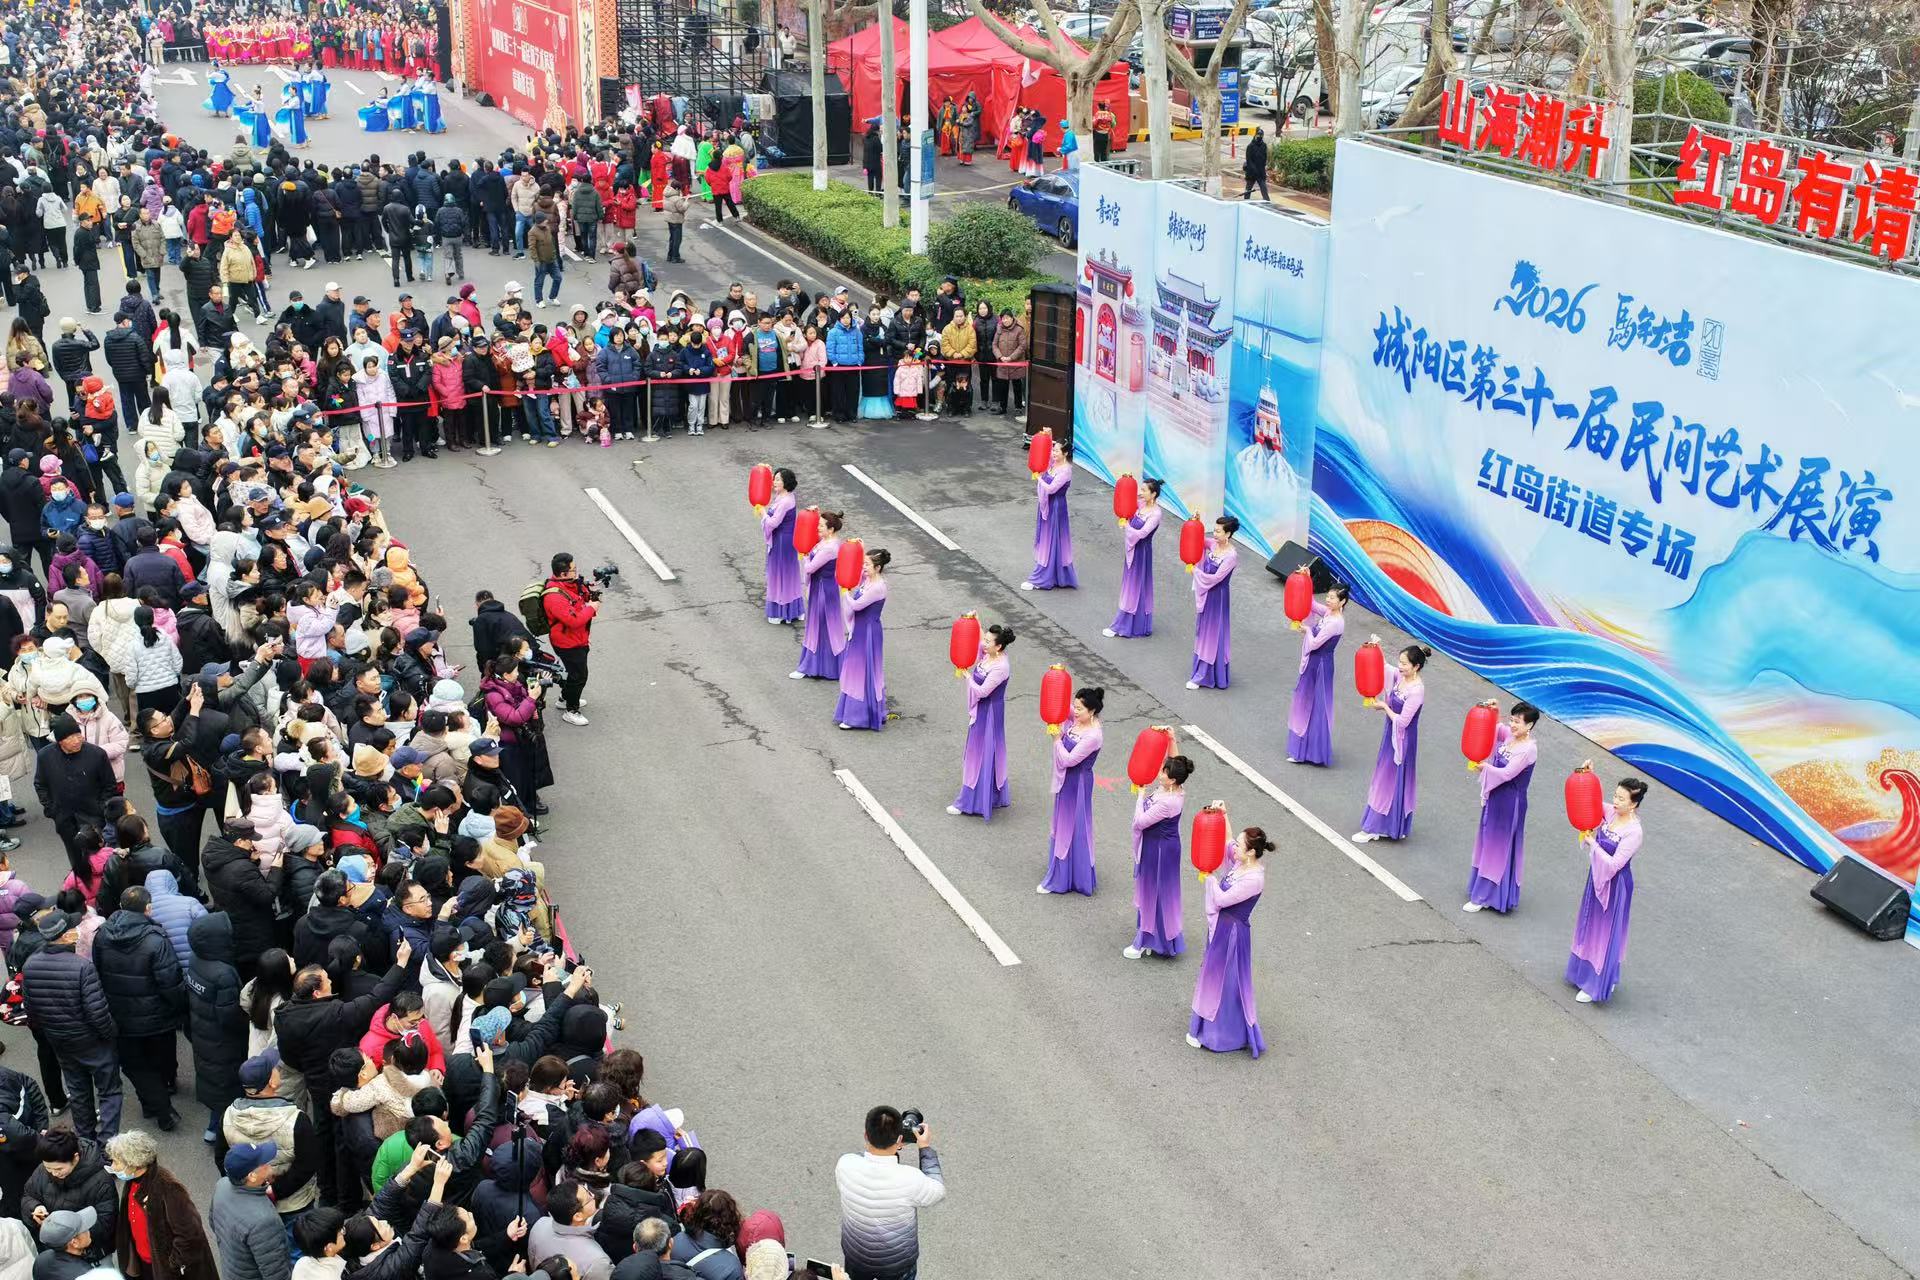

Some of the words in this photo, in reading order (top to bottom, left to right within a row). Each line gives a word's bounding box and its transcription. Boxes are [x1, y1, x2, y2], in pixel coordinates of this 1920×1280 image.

[1438, 79, 1611, 179] 山海潮升
[1674, 124, 1919, 261] 红岛有请
[1095, 194, 1121, 227] 青云宫
[1166, 210, 1206, 252] 韩家民俗村
[1243, 235, 1305, 279] 东大洋游船码头
[1493, 260, 1601, 334] 2026
[1373, 305, 1893, 563] 城阳区第三十一届民间艺术展演
[1477, 448, 1696, 580] 红岛街道专场
